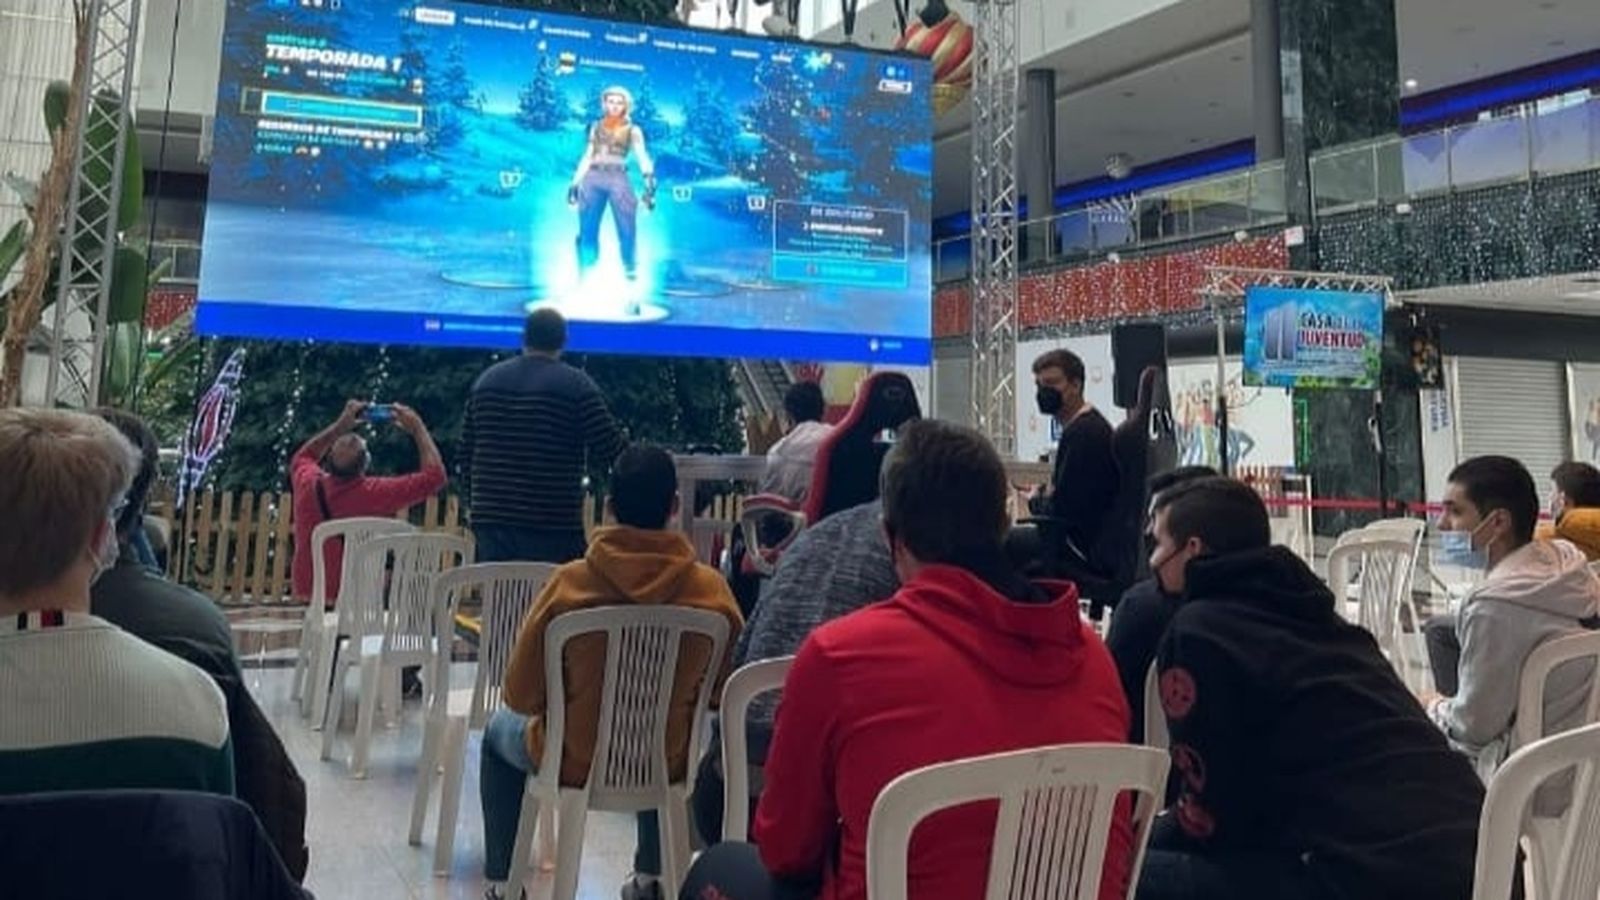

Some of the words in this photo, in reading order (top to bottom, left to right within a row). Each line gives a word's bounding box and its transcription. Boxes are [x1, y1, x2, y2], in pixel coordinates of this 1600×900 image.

[265, 44, 387, 71] TEMPORADA
[392, 57, 403, 73] 1
[1300, 312, 1332, 329] CASA
[1299, 329, 1366, 349] JUVENTUD
